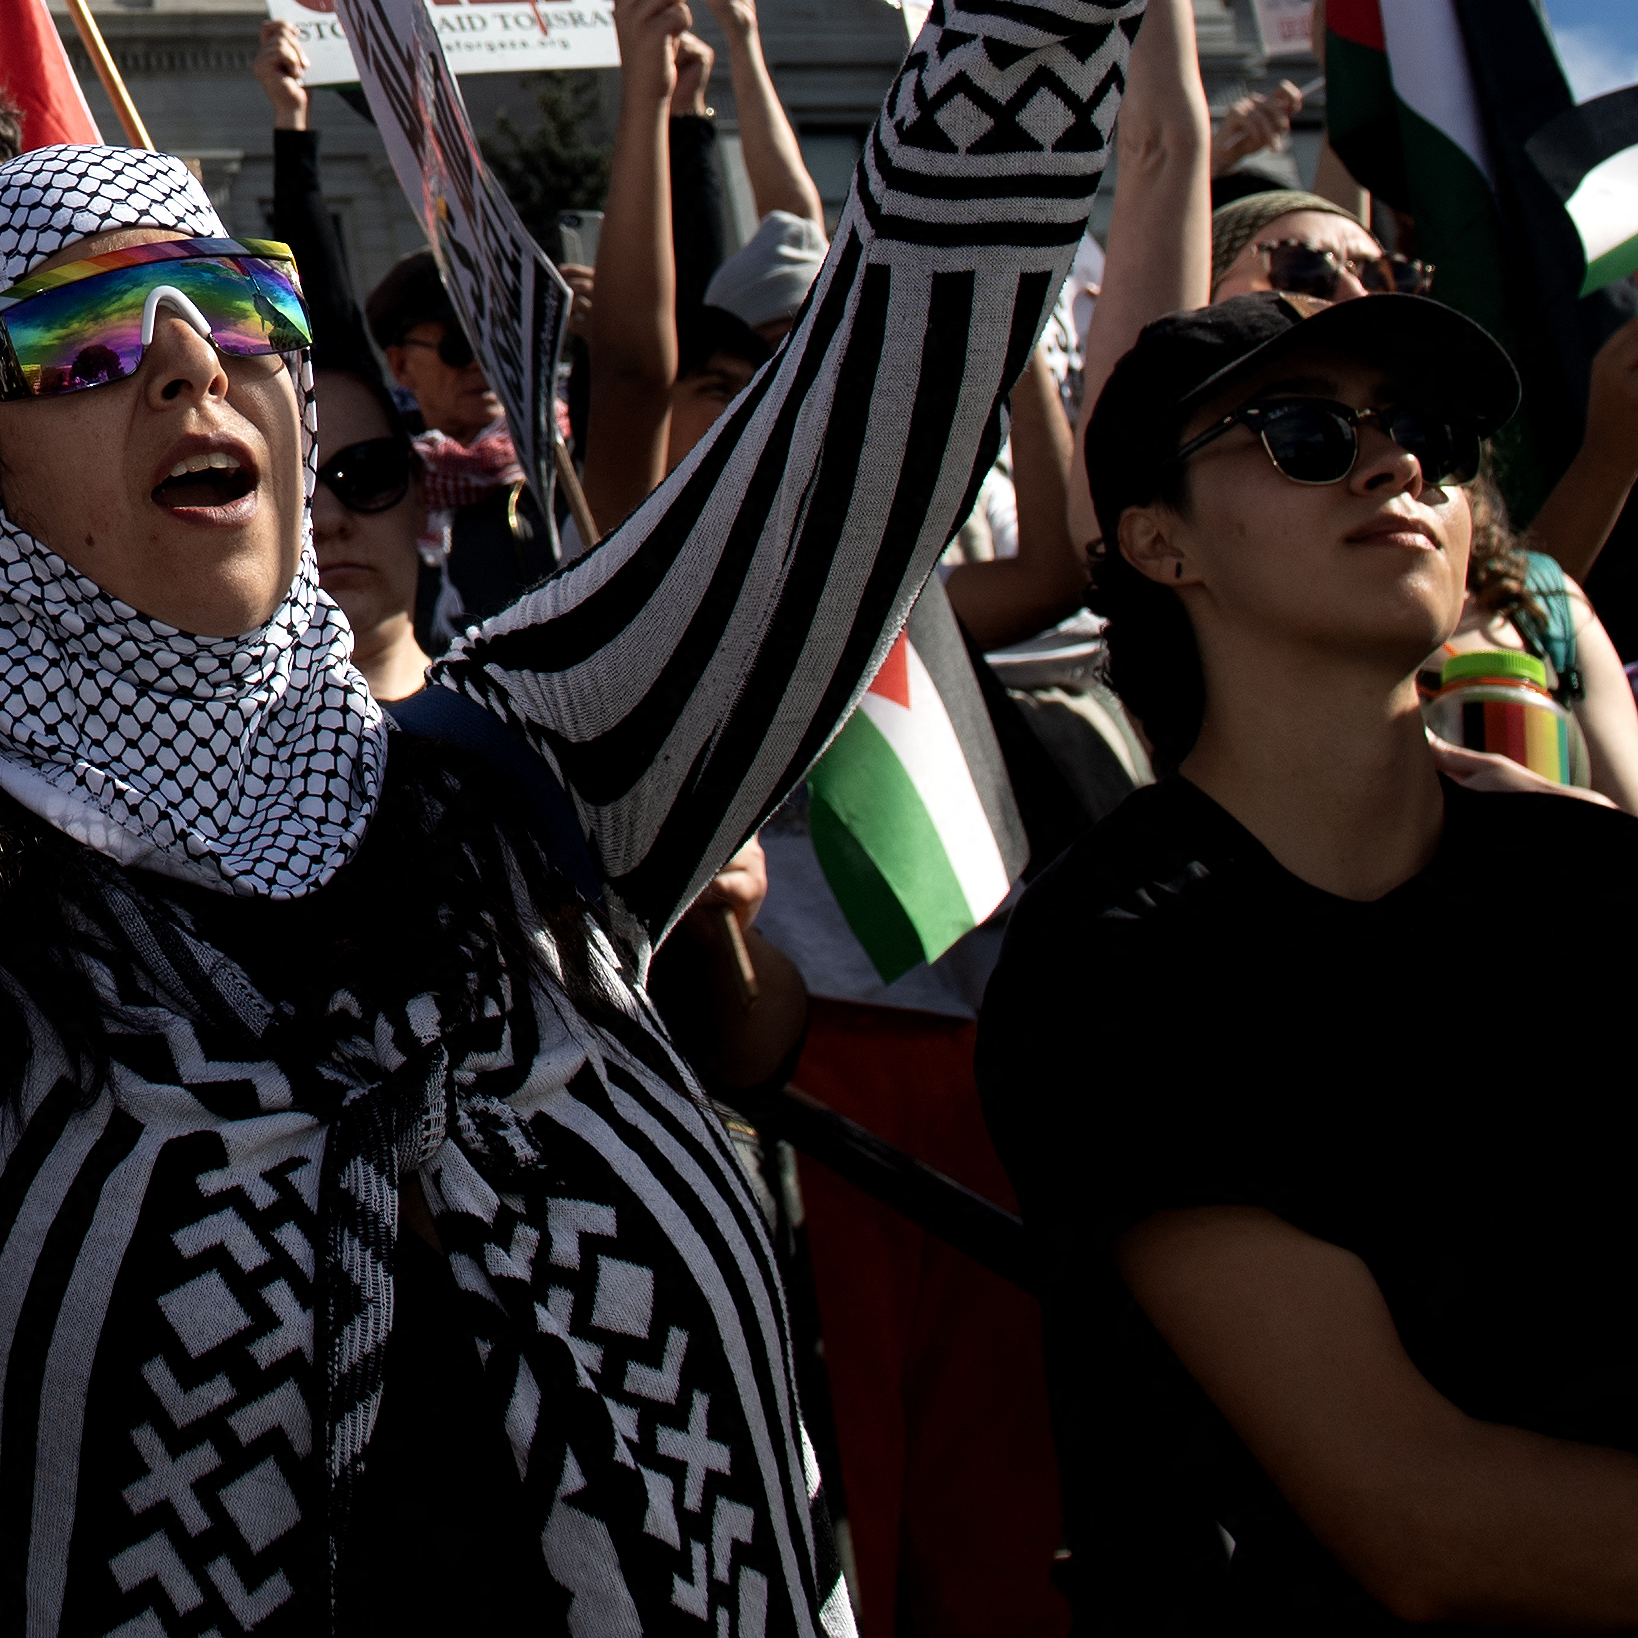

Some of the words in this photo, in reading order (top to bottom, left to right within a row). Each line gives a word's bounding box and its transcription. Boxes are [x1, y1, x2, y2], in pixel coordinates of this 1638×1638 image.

[438, 15, 487, 33] AID
[492, 13, 537, 32] TO
[541, 9, 611, 30] ISRA
